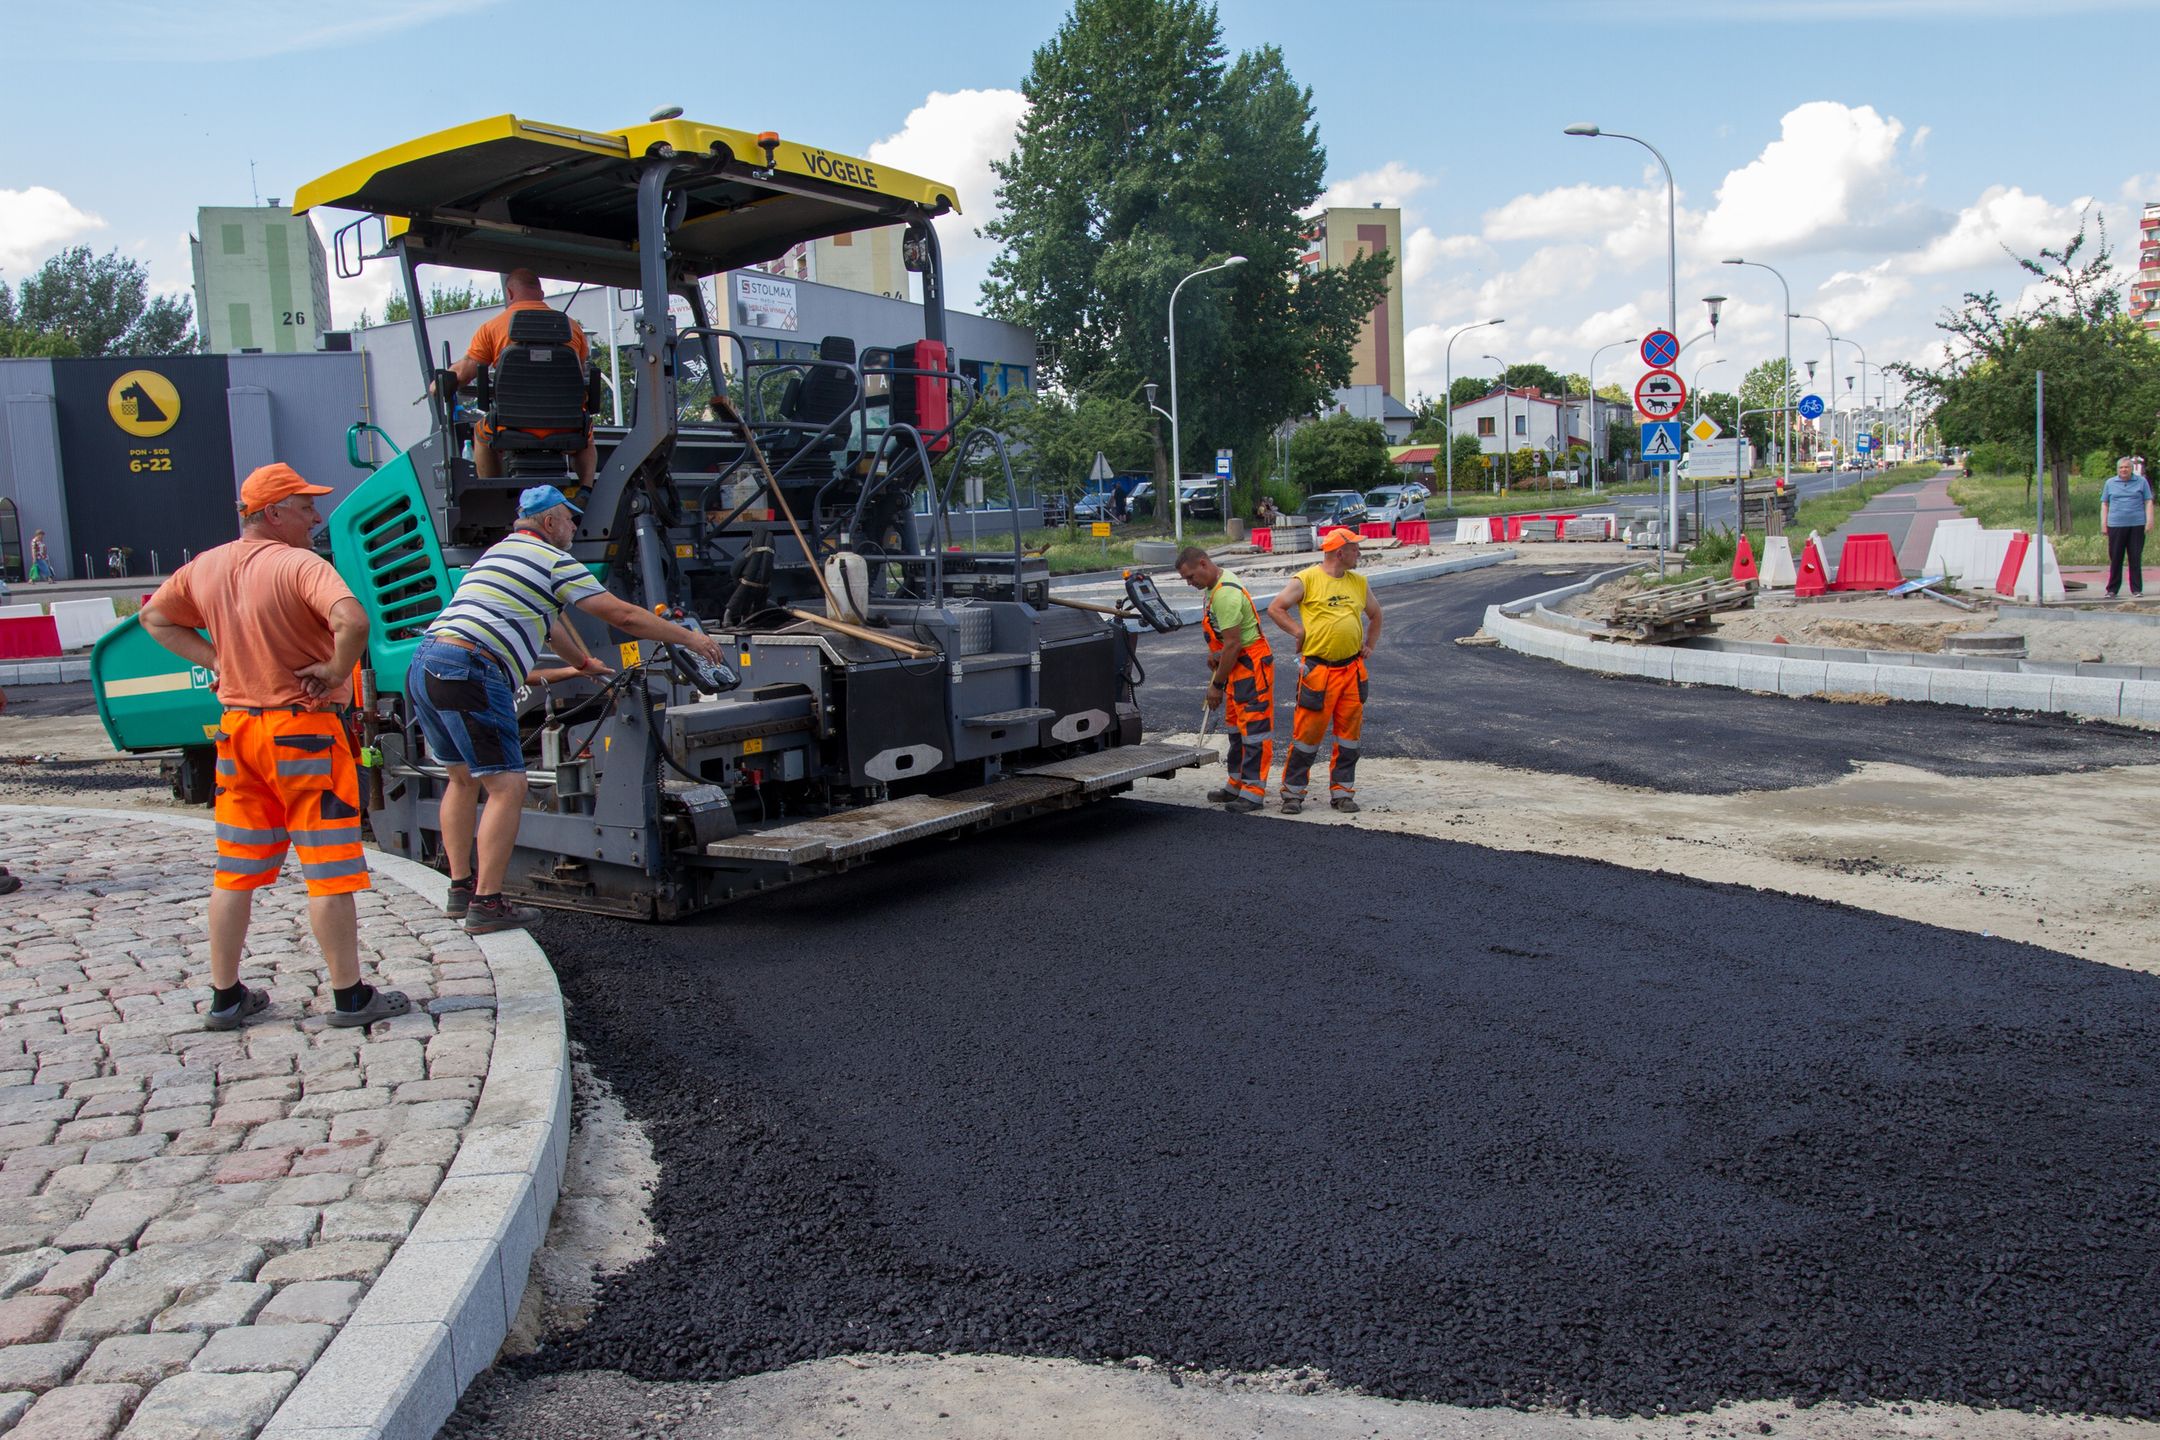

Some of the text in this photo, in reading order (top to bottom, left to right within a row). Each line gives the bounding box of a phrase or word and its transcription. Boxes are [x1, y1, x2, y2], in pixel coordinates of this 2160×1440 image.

[802, 150, 878, 188] VÖGELE
[751, 282, 792, 299] STOLMAX
[282, 311, 305, 326] 26
[130, 457, 172, 473] 6-22
